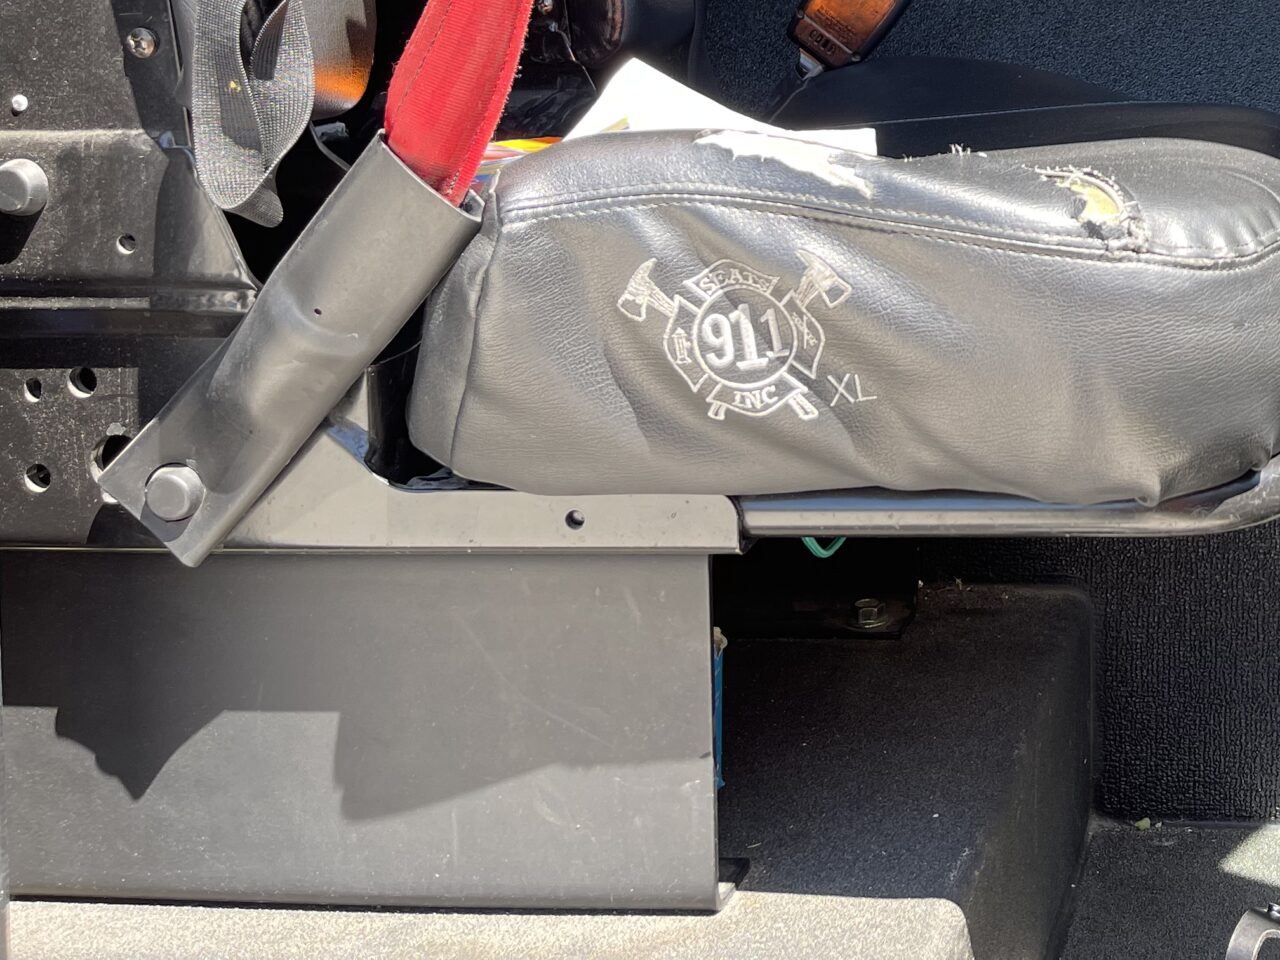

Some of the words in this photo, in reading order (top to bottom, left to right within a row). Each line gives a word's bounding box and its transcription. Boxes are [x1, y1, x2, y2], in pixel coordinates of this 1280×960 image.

[699, 268, 770, 296] SEATS
[702, 303, 790, 371] 911
[731, 385, 779, 410] INC
[827, 373, 878, 407] XL
